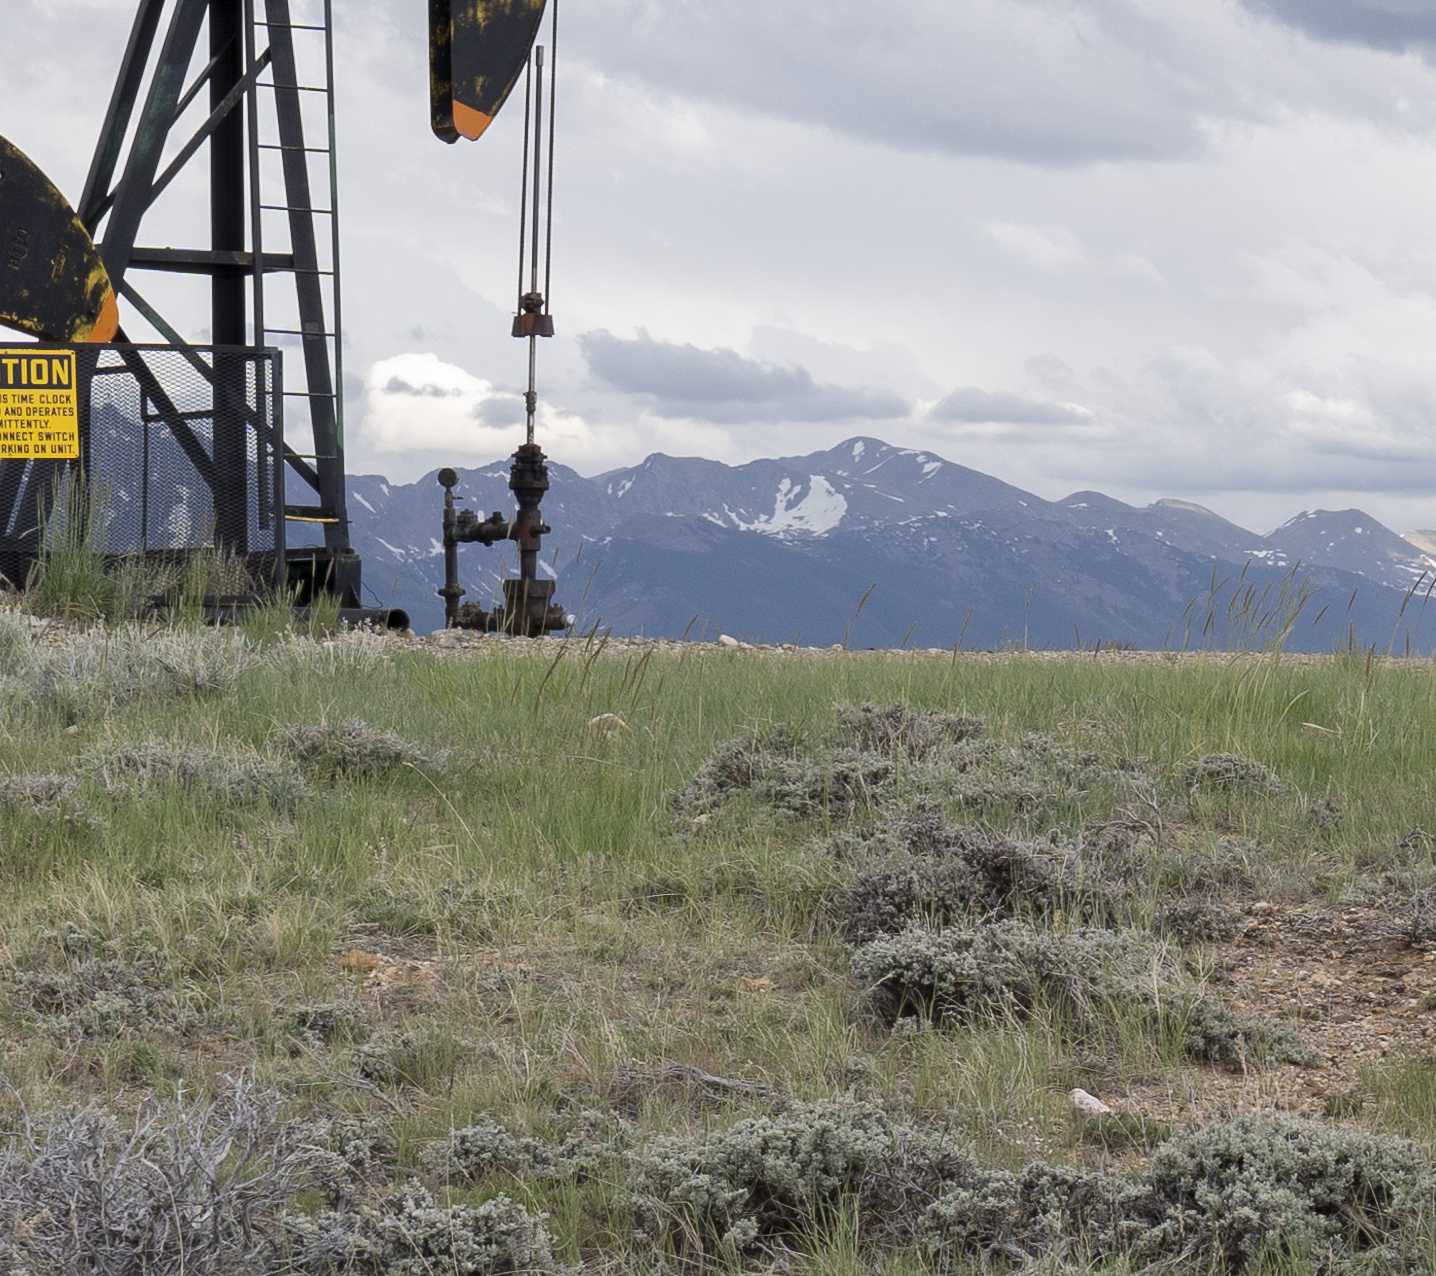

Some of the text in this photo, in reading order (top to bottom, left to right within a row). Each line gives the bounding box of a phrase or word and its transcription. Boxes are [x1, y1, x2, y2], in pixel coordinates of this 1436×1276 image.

[0, 394, 8, 404] IS
[12, 394, 35, 404] TIME
[39, 394, 71, 404] CLOCK
[4, 407, 23, 417] AND
[25, 407, 74, 417] OPERATES
[38, 432, 75, 442] SWITCH
[34, 444, 47, 454] ON
[51, 445, 75, 455] UNIT.
